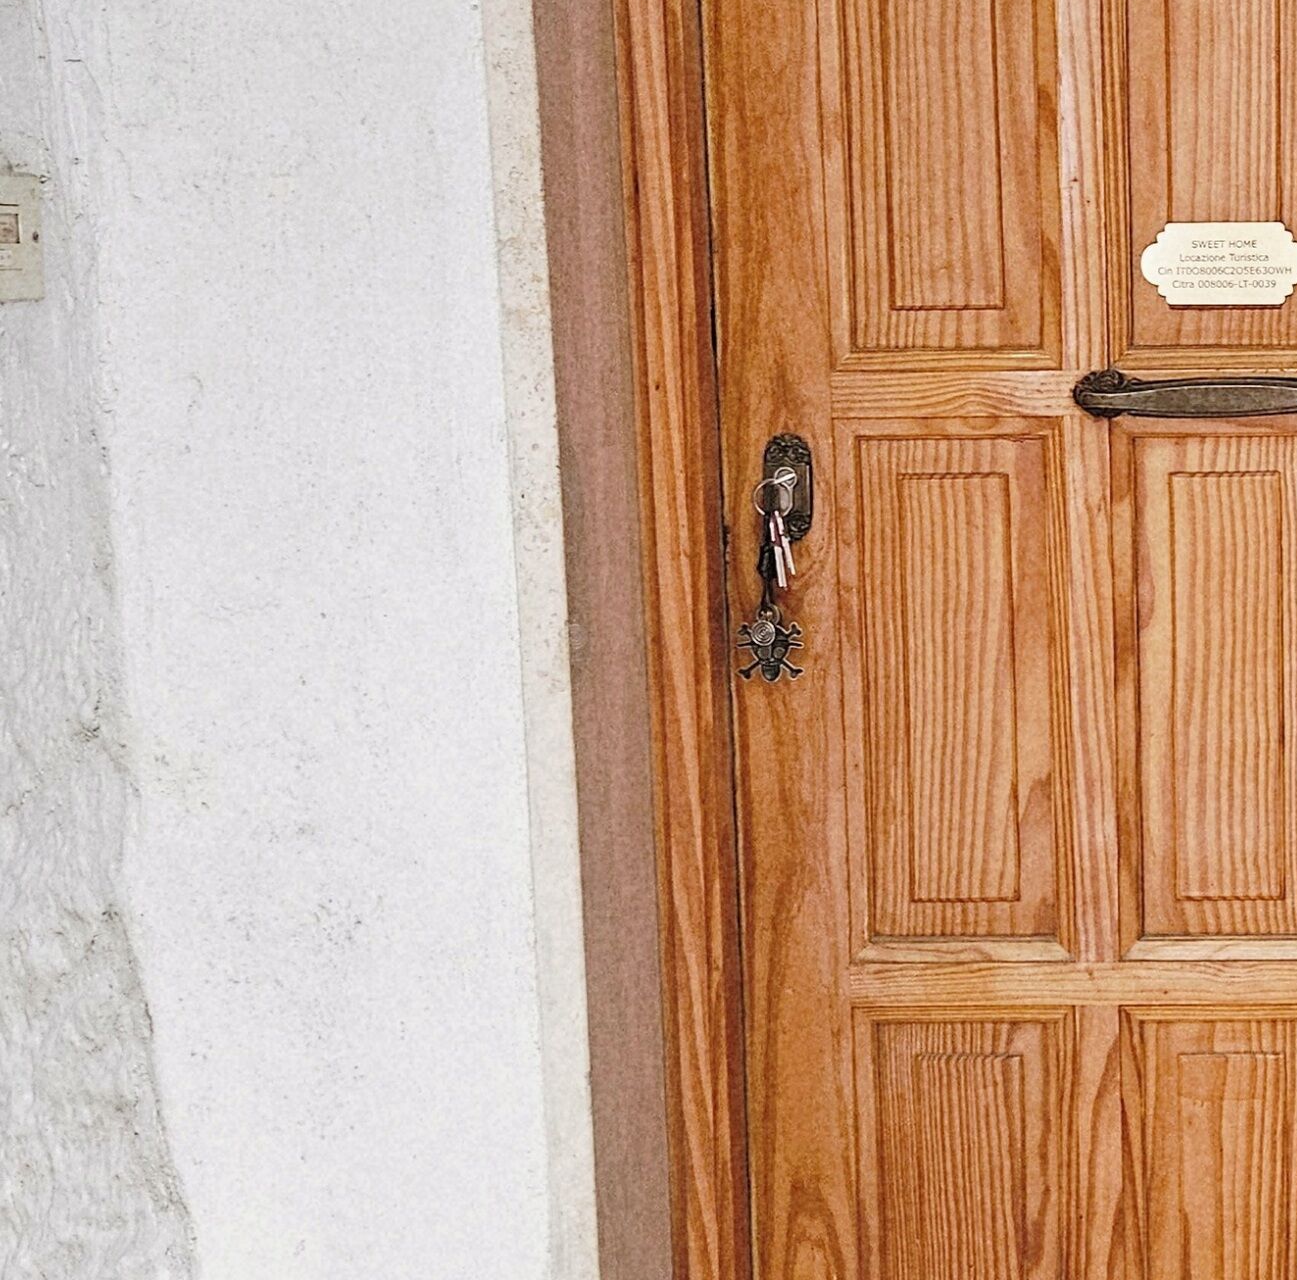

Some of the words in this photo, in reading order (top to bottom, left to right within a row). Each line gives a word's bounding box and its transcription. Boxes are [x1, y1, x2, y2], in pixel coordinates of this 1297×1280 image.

[1191, 240, 1226, 249] SWEET
[1228, 239, 1258, 248] HOME
[1179, 253, 1226, 262] Locazione
[1228, 252, 1270, 261] Turistica
[1172, 279, 1195, 289] Citra
